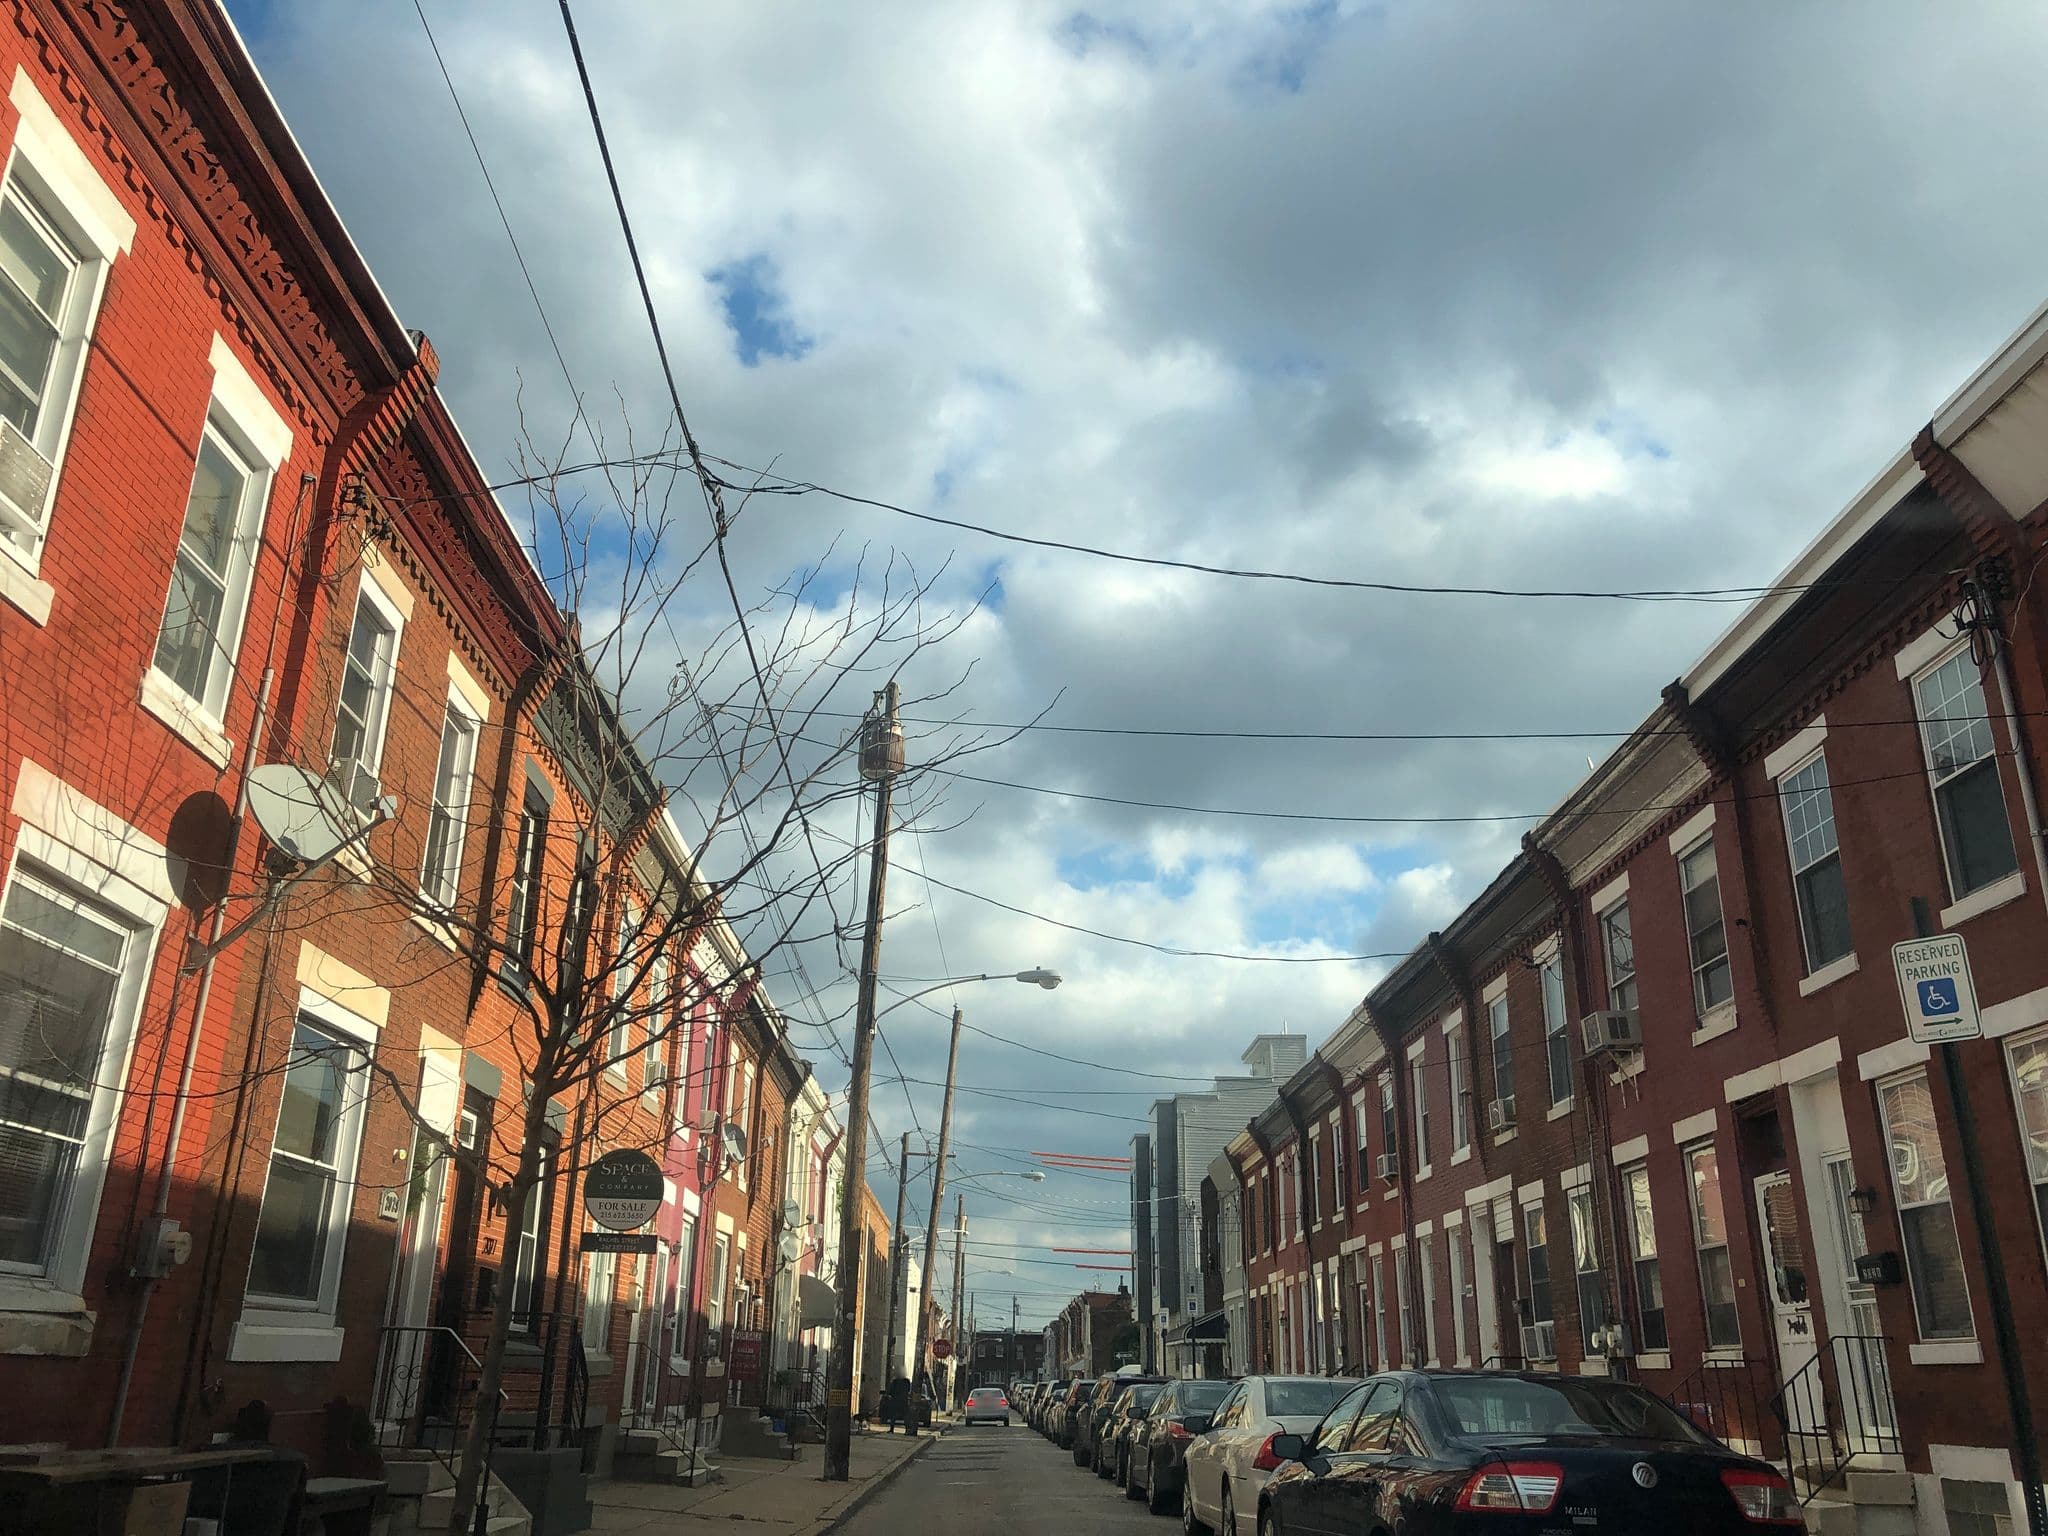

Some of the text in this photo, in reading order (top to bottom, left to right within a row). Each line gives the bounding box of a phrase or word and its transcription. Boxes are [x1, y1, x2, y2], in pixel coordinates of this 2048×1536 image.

[1899, 943, 1960, 964] RESERVED
[1905, 961, 1960, 981] PARKING
[600, 1163, 650, 1176] SPACE
[620, 1175, 629, 1183] &
[599, 1183, 649, 1191] COMPANY
[598, 1201, 647, 1212] FOR SALE
[934, 1344, 951, 1353] STOP
[1565, 1506, 1597, 1516] MILAN
